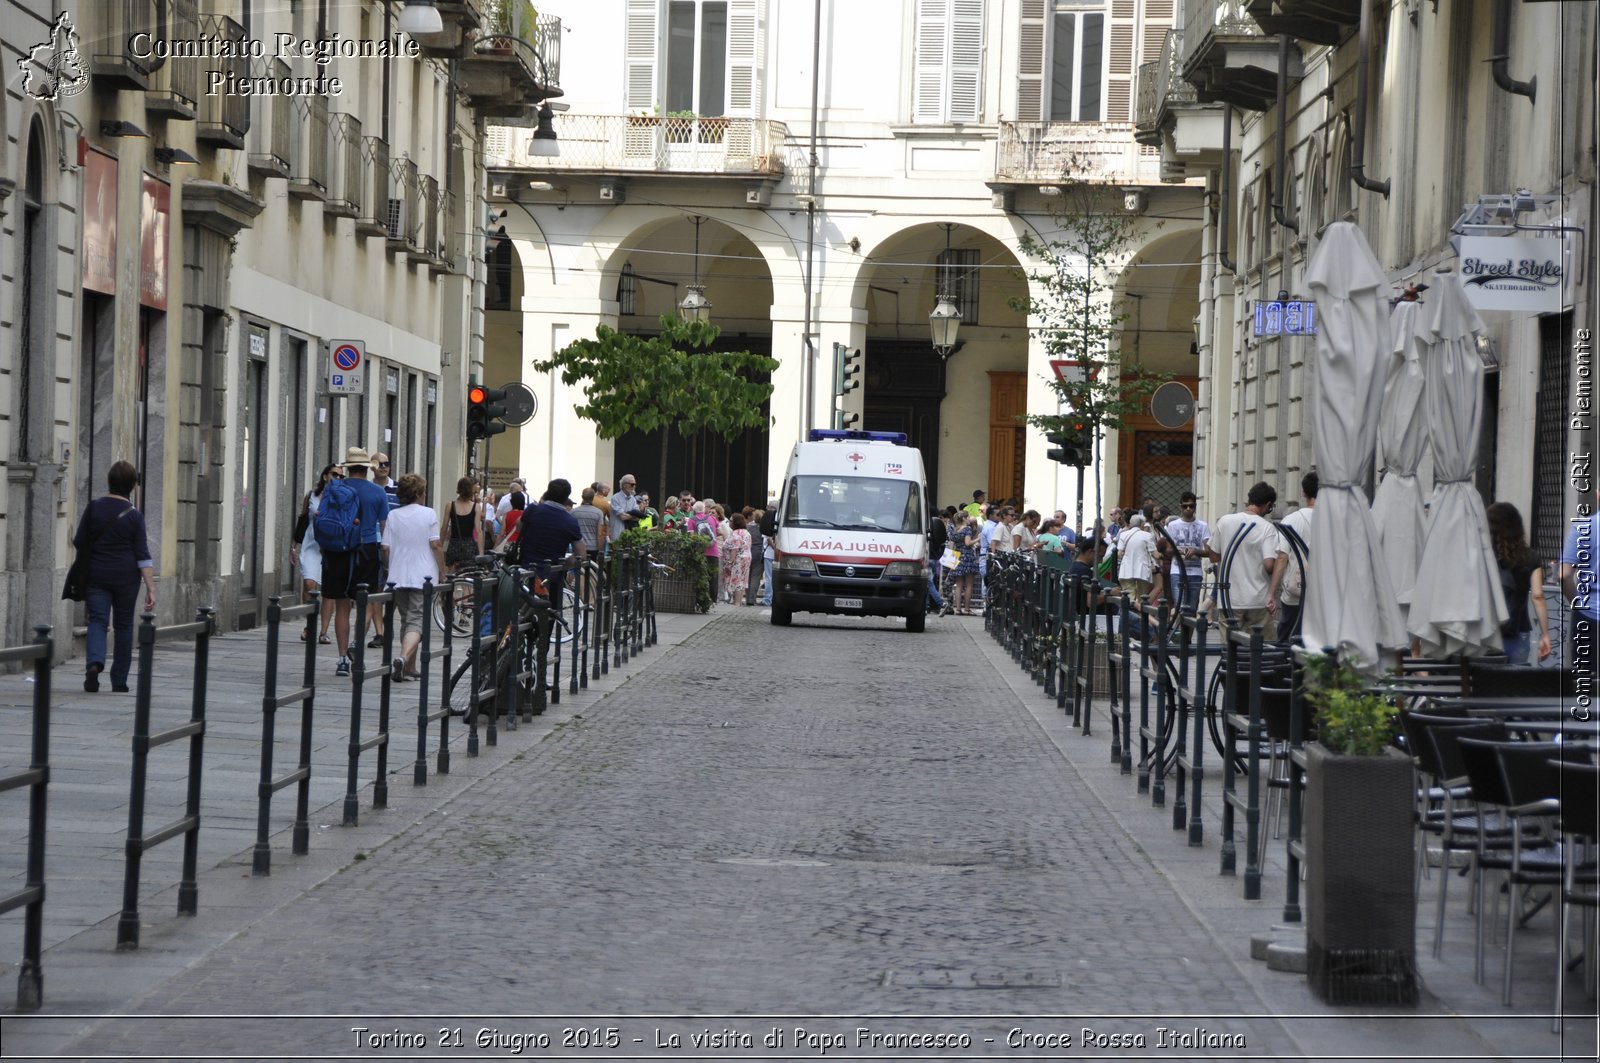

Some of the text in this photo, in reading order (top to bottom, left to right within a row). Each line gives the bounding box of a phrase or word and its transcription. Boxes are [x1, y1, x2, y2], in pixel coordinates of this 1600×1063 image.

[1462, 258, 1562, 281] Street Style
[1484, 284, 1546, 292] SKATEBOARDING
